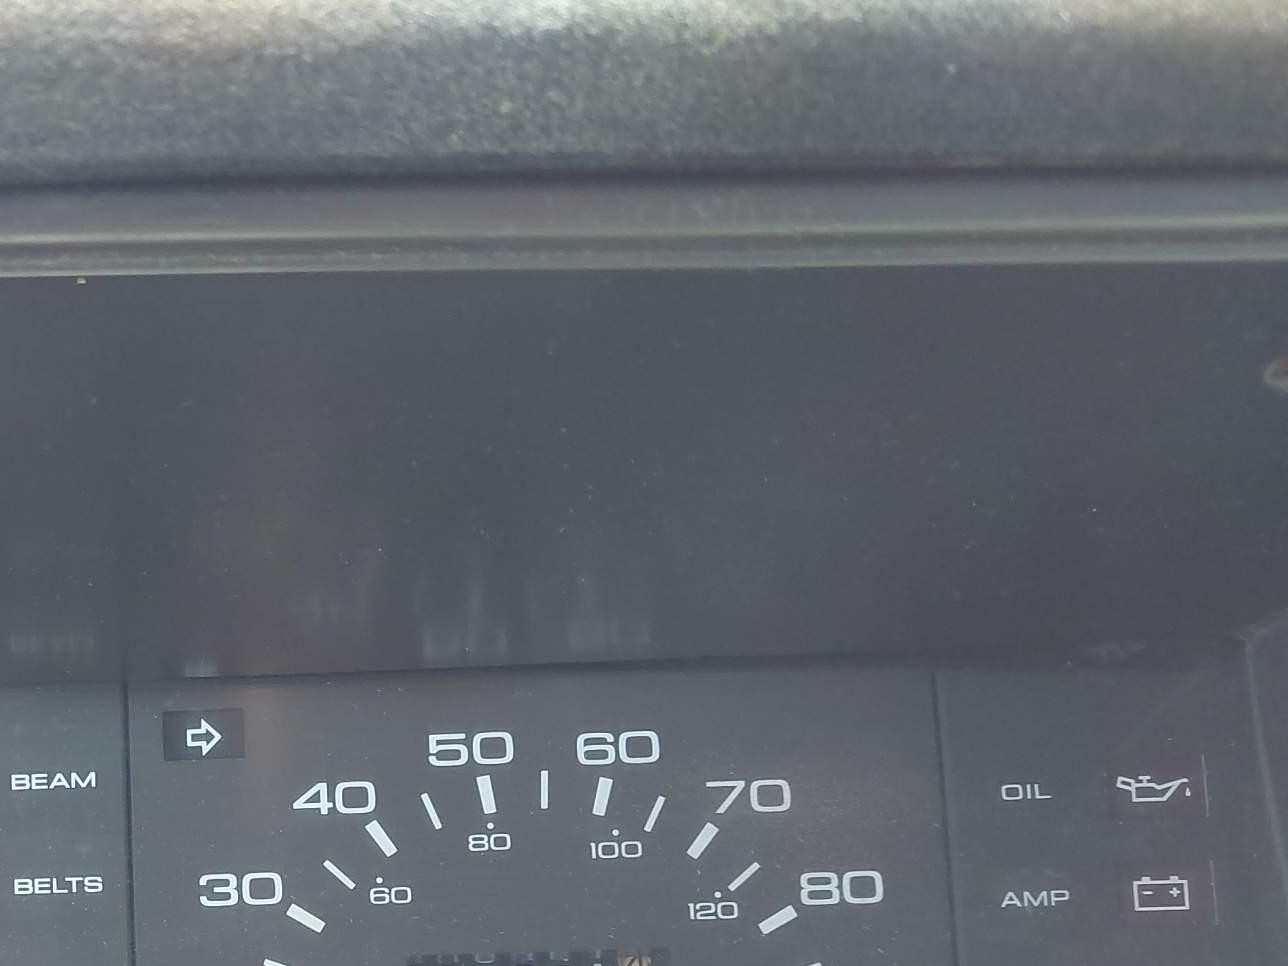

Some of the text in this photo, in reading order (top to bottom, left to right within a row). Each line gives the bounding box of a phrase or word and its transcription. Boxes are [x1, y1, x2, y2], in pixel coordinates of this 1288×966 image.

[428, 731, 514, 767] 50
[576, 730, 660, 766] 60
[11, 772, 97, 790] BEAM
[292, 781, 377, 814] 40
[705, 779, 792, 814] 70
[1001, 783, 1052, 800] OIL
[468, 833, 512, 851] 80
[590, 841, 643, 859] 100
[14, 876, 103, 895] BELTS
[199, 872, 283, 907] 30
[800, 870, 884, 905] 80
[369, 886, 412, 904] 60
[1001, 890, 1070, 908] AMP
[688, 902, 739, 920] 120
